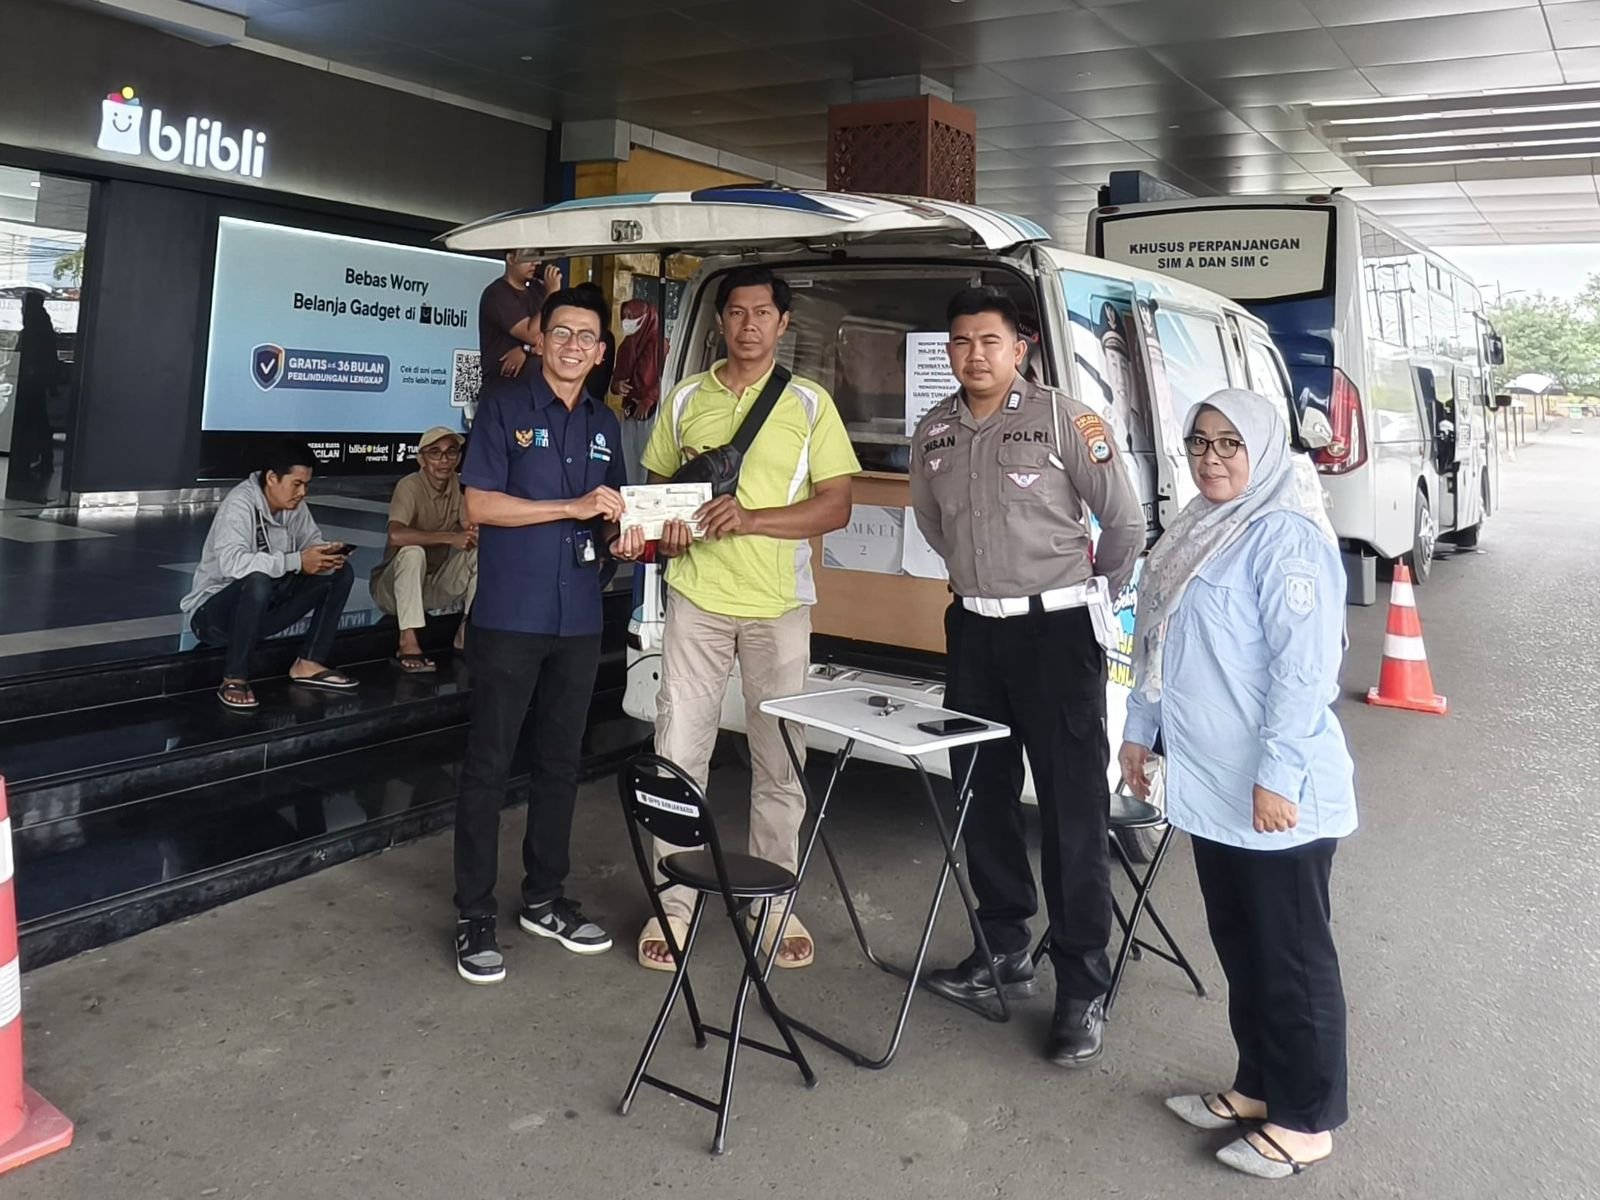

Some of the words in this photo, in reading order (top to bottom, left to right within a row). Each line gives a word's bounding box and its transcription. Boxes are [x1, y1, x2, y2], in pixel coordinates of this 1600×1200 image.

[149, 108, 266, 178] blibli
[1129, 241, 1185, 254] KHUSUS
[1188, 238, 1300, 252] PERPANJANGAN
[1157, 257, 1181, 269] SIM
[1185, 257, 1195, 268] A
[1198, 256, 1226, 268] DAN
[1231, 256, 1255, 267] SIM
[1259, 255, 1269, 267] C
[345, 267, 387, 289] Bebas
[390, 273, 429, 296] Worry
[293, 292, 346, 317] Belanja
[350, 298, 401, 321] Gadget
[405, 307, 416, 320] di
[434, 307, 468, 327] blibli
[289, 357, 327, 370] GRATIS
[337, 360, 350, 372] 36
[351, 361, 384, 374] BULAN
[287, 371, 348, 383] PERLINDUNGAN
[350, 375, 384, 385] LENGKAP
[1002, 430, 1049, 444] POLRI
[313, 449, 340, 458] CILAN
[859, 544, 868, 556] 2
